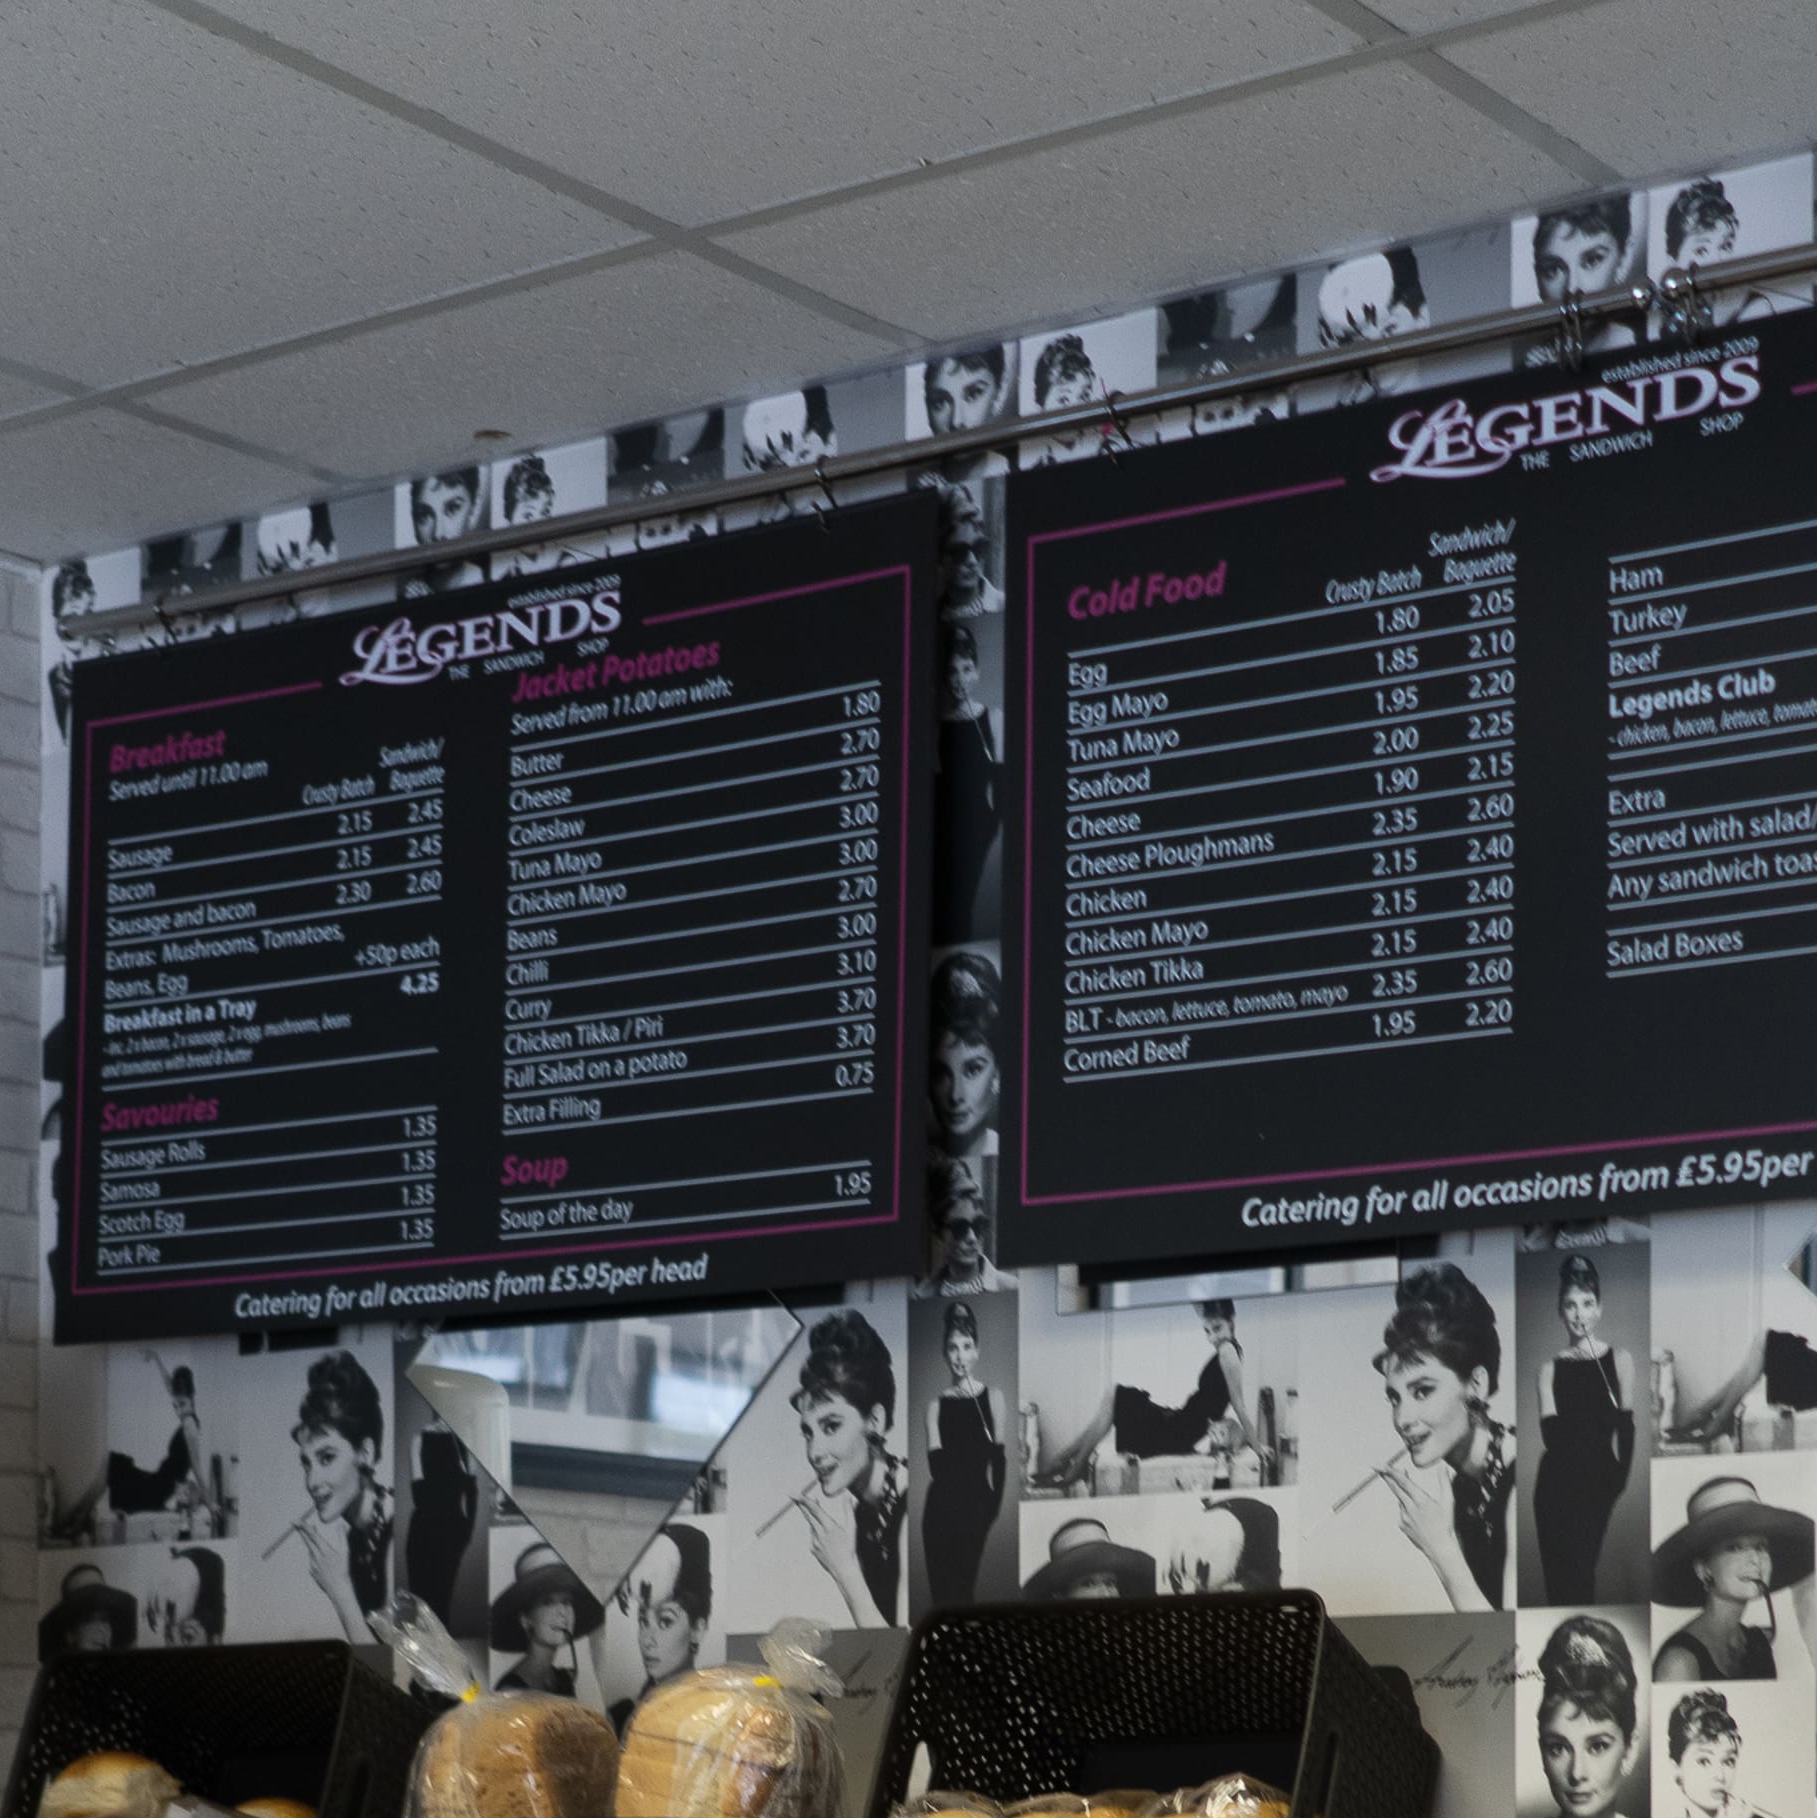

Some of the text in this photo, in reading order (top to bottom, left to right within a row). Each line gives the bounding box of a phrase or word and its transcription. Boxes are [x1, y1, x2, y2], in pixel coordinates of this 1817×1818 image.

[1369, 355, 1762, 484] LEGENDS
[1518, 410, 1744, 471] THE SANDWICH SHOP
[1067, 559, 1227, 620] Cold Food
[339, 591, 622, 687] LEGENDS
[511, 640, 720, 703] Jacket Potatoes
[1066, 627, 1516, 728] Egg Mayo 1.85 2.10
[1608, 678, 1713, 719] Legends
[1716, 667, 1776, 700] Club
[108, 729, 226, 773] Breakfast
[1065, 791, 1515, 879] Cheese Ploughmans 2.35 2.60
[1606, 820, 1687, 857] Served
[1690, 813, 1745, 845] with
[1606, 873, 1654, 900] Any
[1657, 852, 1769, 892] sandwich
[1606, 932, 1669, 967] Salad
[1674, 929, 1744, 958] Boxes
[503, 1028, 573, 1056] Chicken
[574, 1020, 621, 1046] Tikka
[633, 1014, 663, 1039] Piri
[836, 985, 877, 1013] 3.70
[1062, 997, 1513, 1072] Corned Beef 1.95 2.20
[502, 1021, 876, 1089] Full Salad on a potato 3.70
[100, 1094, 219, 1132] Savouries
[502, 1060, 875, 1126] Extra Filling 0.75
[499, 1170, 872, 1232] Soup of the day 1.95
[500, 1154, 568, 1187] Soup
[97, 1182, 435, 1235] Scotch Egg 1.35
[233, 1289, 322, 1319] Catering
[323, 1284, 358, 1317] for
[358, 1281, 387, 1308] all
[387, 1276, 491, 1306] occasions
[492, 1269, 545, 1303] from
[649, 1251, 709, 1284] head
